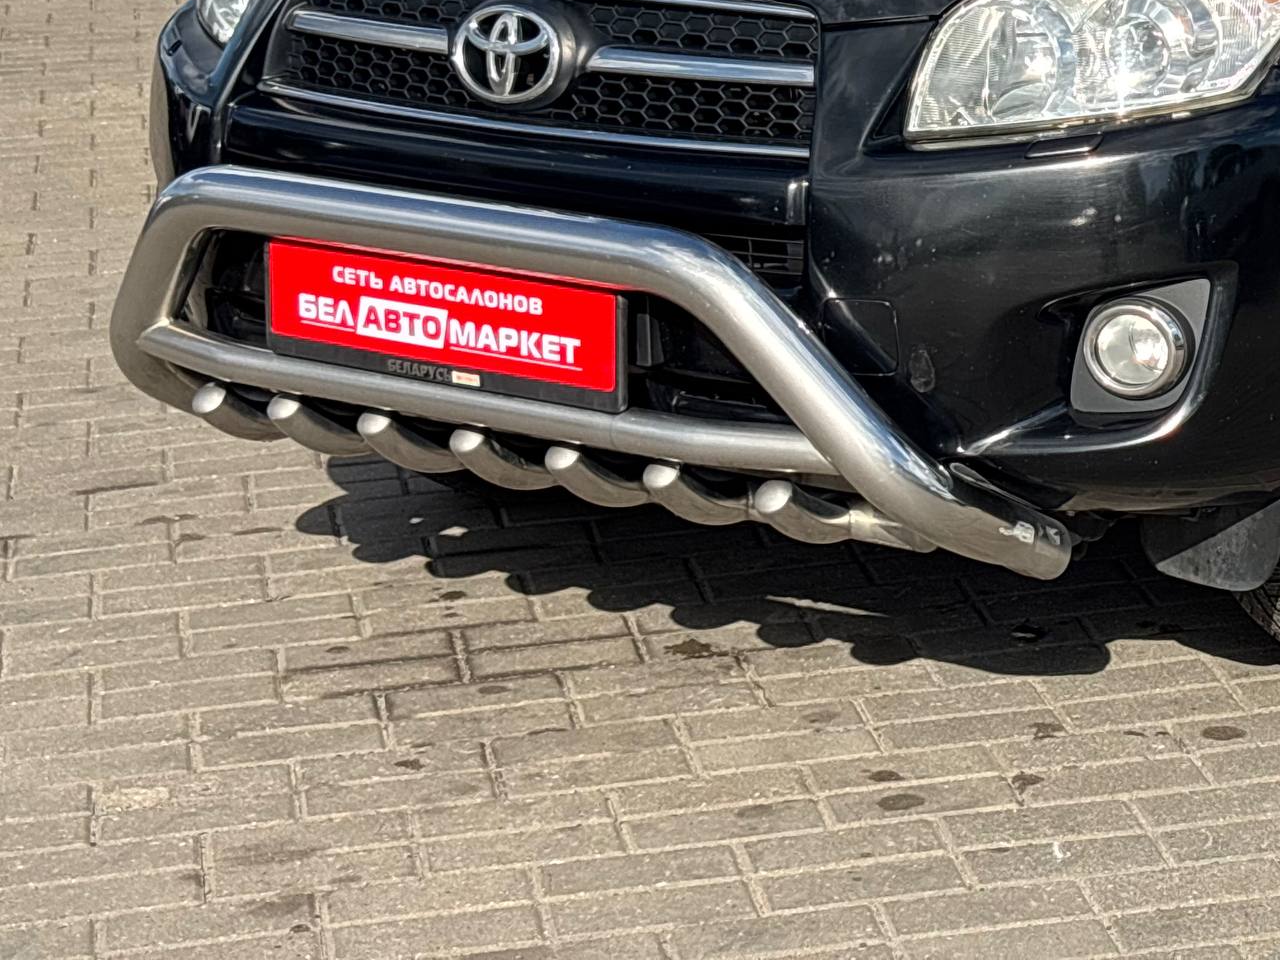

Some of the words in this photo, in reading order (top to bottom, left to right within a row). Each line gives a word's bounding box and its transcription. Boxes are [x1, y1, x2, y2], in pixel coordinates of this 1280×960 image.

[332, 266, 383, 289] СЕТЬ
[390, 275, 543, 315] АВТОСАЛОНОВ
[388, 359, 452, 381] БЕЛАРУСЬ
